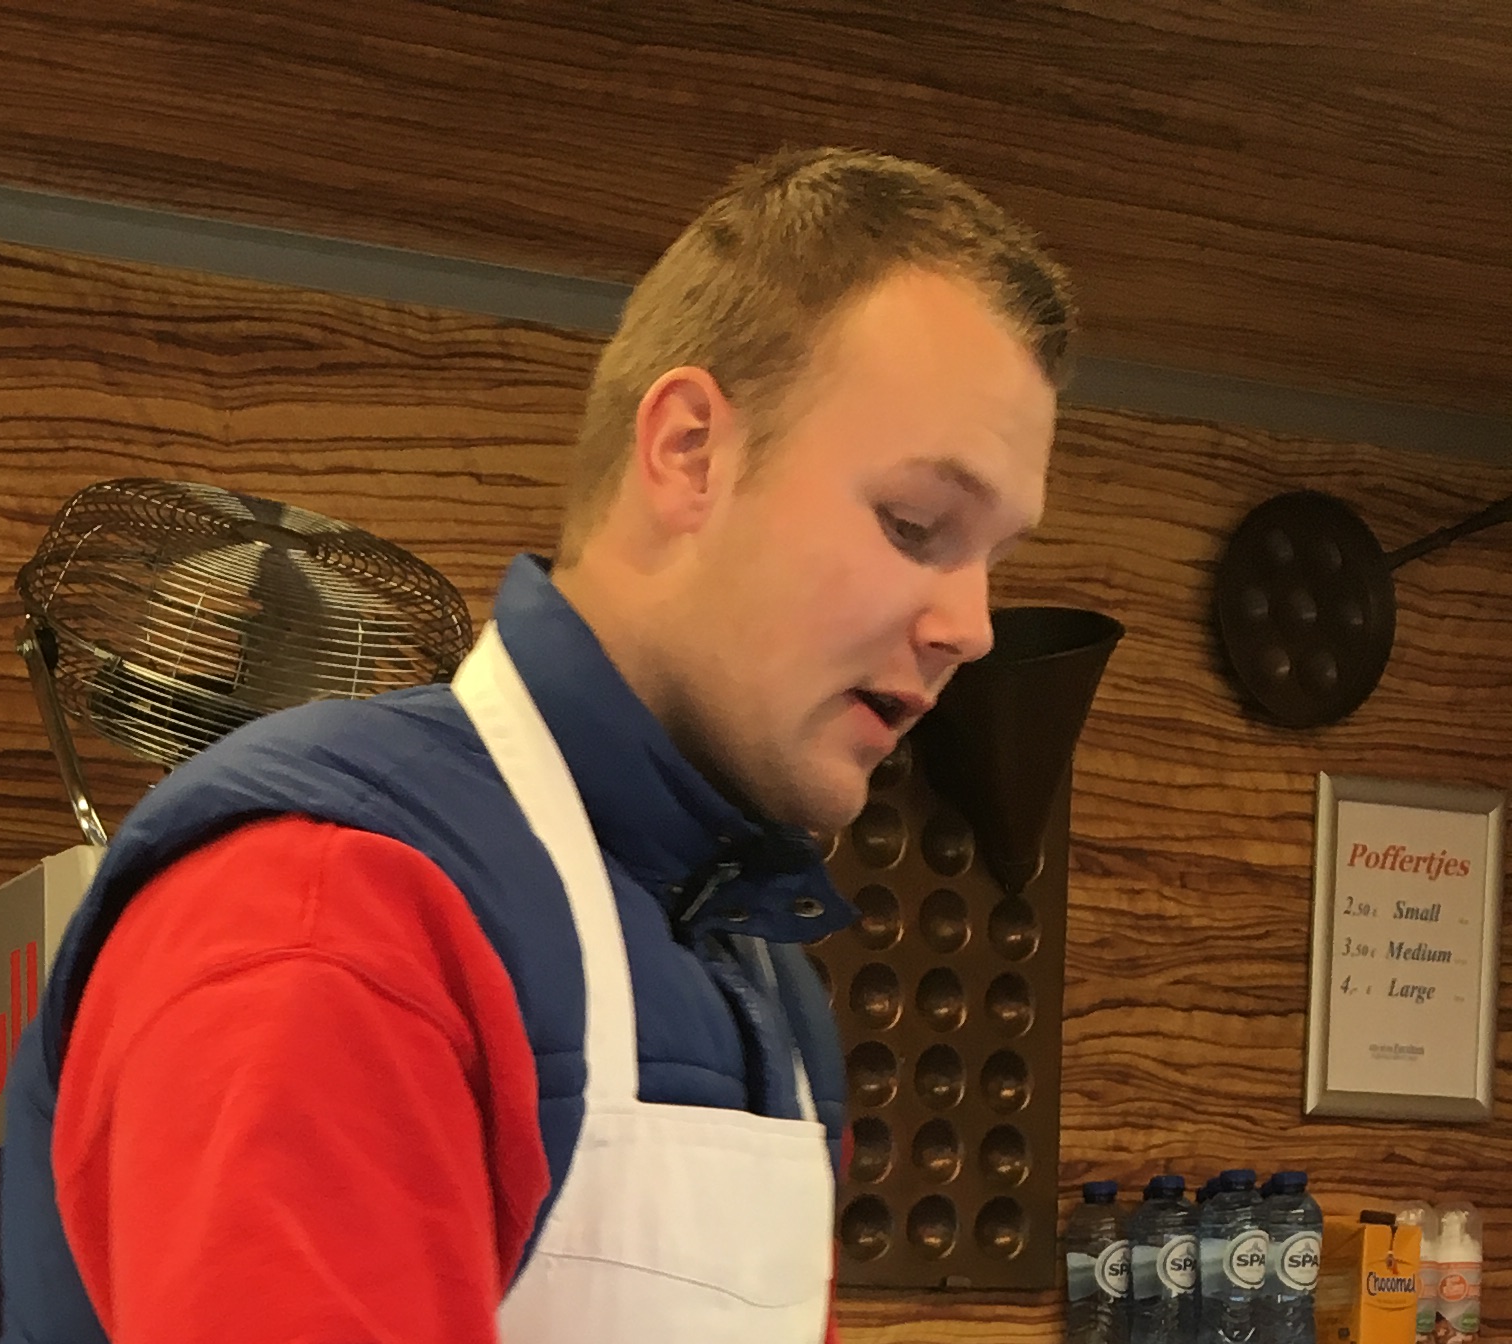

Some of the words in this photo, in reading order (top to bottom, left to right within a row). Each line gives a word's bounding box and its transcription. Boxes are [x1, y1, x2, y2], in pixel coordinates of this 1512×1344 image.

[1347, 843, 1471, 881] Poffertjes
[1393, 900, 1441, 922] Small
[1386, 941, 1452, 963] Medium
[1388, 978, 1436, 1004] Large
[1288, 1252, 1319, 1268] SPA
[1366, 1271, 1417, 1296] Chocomel
